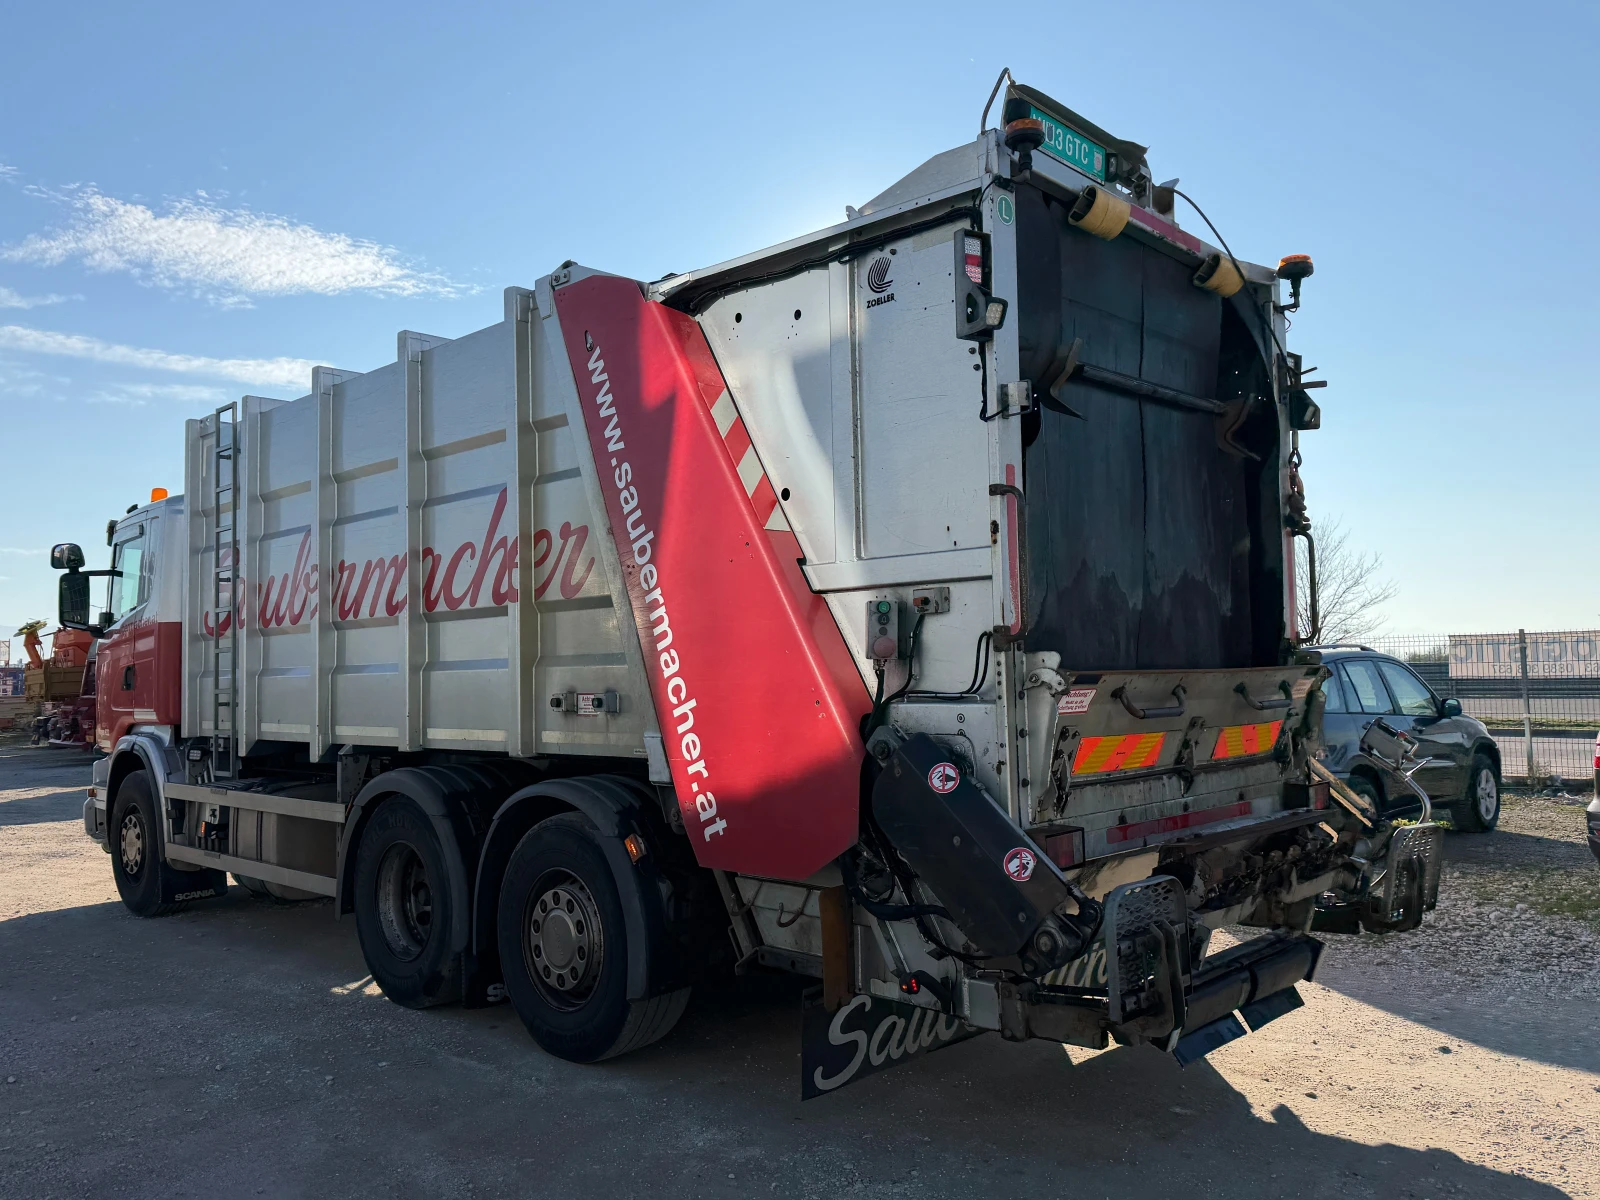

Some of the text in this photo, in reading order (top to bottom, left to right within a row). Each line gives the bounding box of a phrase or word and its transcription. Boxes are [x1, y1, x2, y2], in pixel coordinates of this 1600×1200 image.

[1002, 200, 1010, 220] L
[866, 293, 896, 309] ZOELLER
[587, 347, 728, 843] www.saubermacher.at
[174, 889, 216, 901] SCANIA
